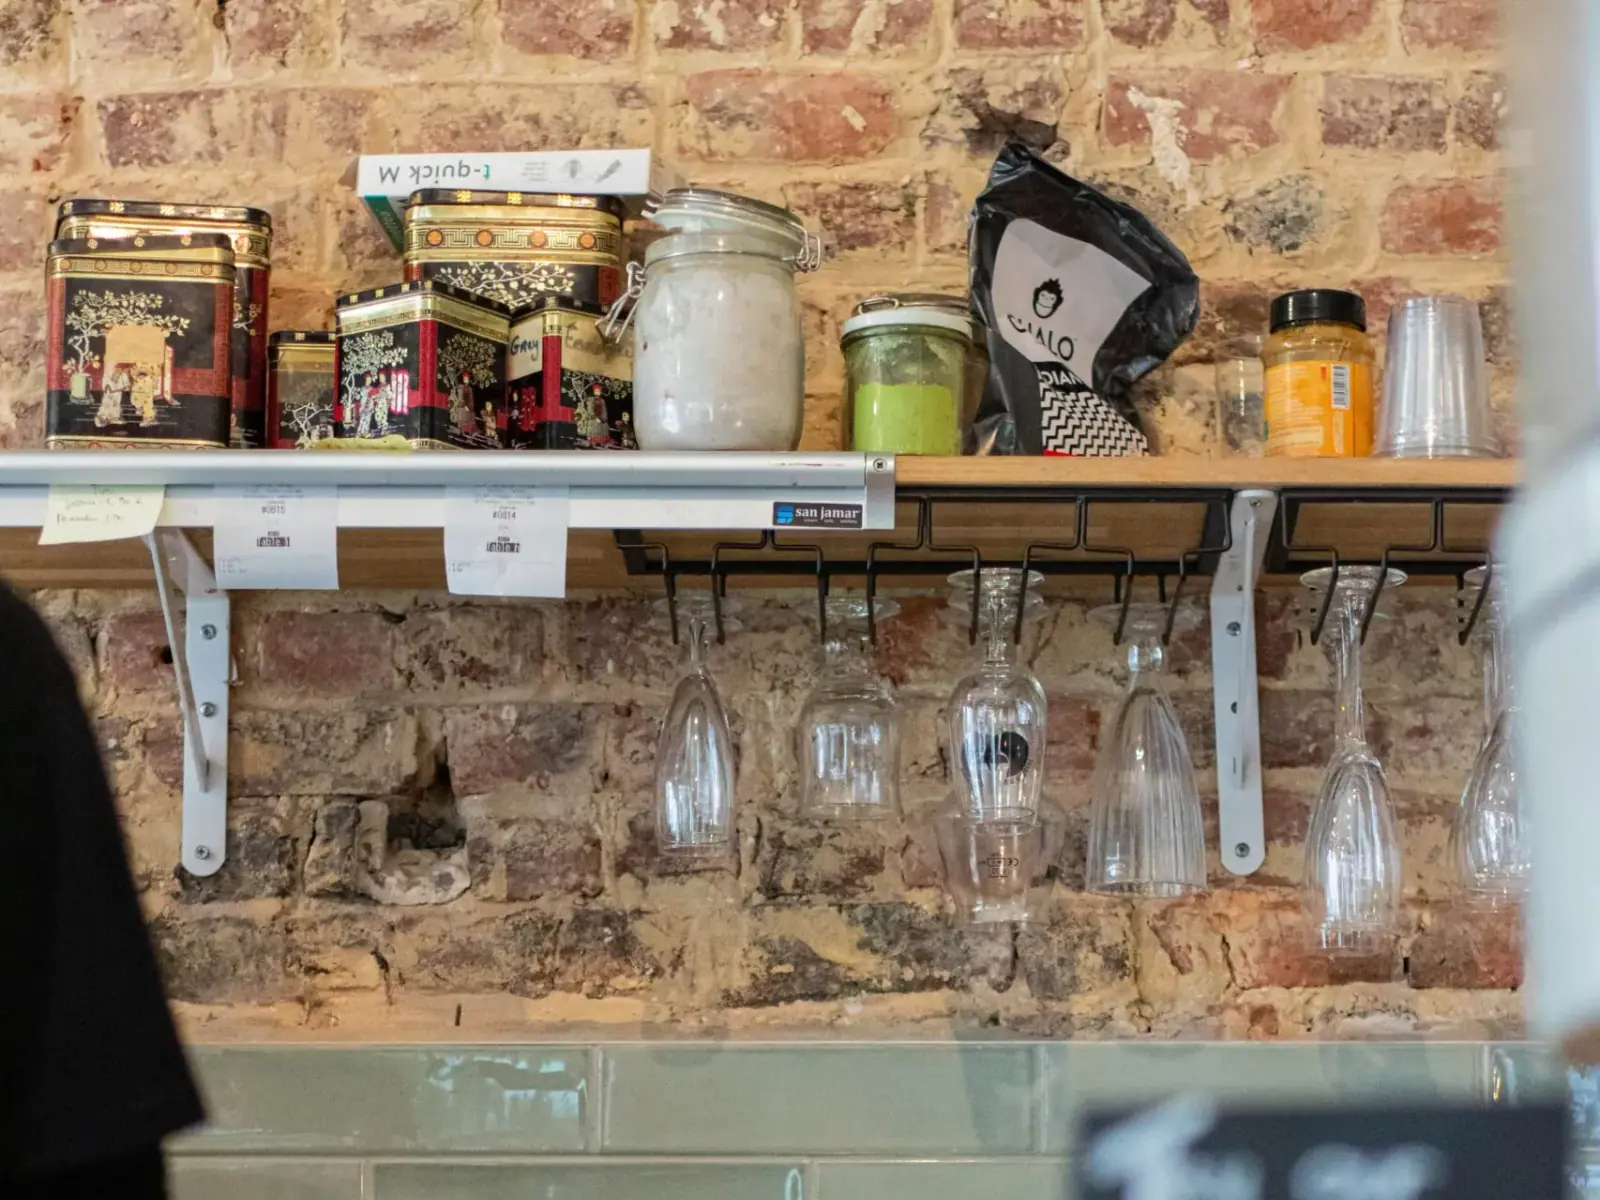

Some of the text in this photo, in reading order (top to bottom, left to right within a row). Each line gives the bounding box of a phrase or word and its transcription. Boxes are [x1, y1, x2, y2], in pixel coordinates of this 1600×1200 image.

[379, 159, 491, 185] t-quick M
[795, 506, 859, 520] san jamar
